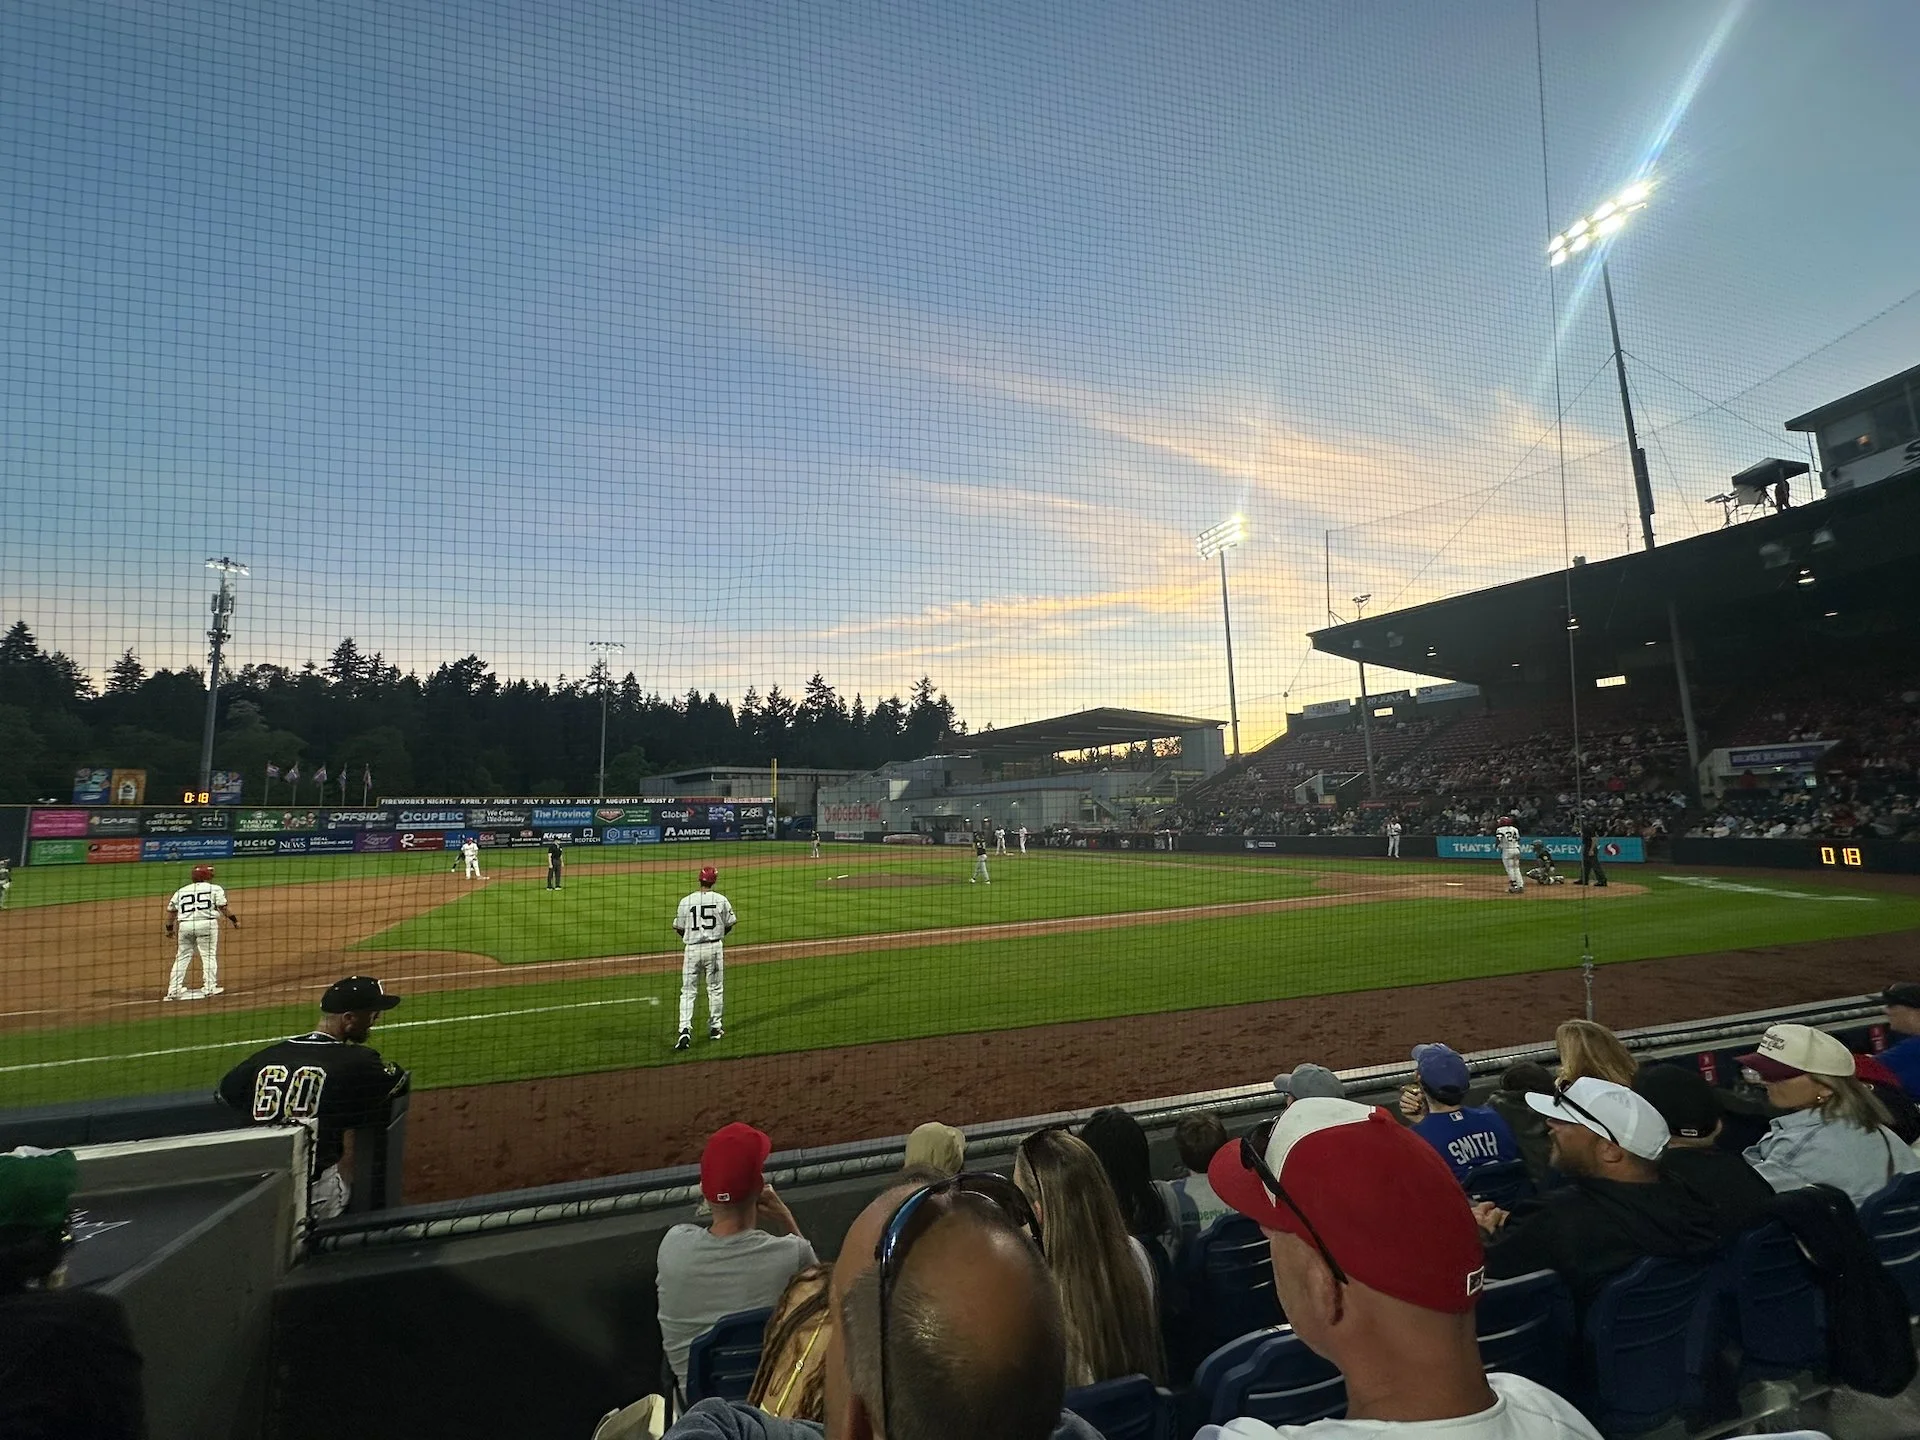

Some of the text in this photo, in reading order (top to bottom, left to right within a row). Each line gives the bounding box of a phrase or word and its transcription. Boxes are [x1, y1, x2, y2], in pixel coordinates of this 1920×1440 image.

[184, 792, 209, 803] 0:18
[329, 812, 388, 821] OFFSIDE
[534, 810, 551, 818] The
[552, 810, 592, 818] Province
[661, 810, 689, 819] Global
[678, 828, 711, 836] AMRIZE
[233, 839, 277, 847] MUCHO
[1452, 843, 1491, 853] THAT'S
[180, 891, 212, 914] 25
[690, 904, 717, 931] 15
[252, 1065, 327, 1121] 60
[1447, 1131, 1499, 1166] SMITH
